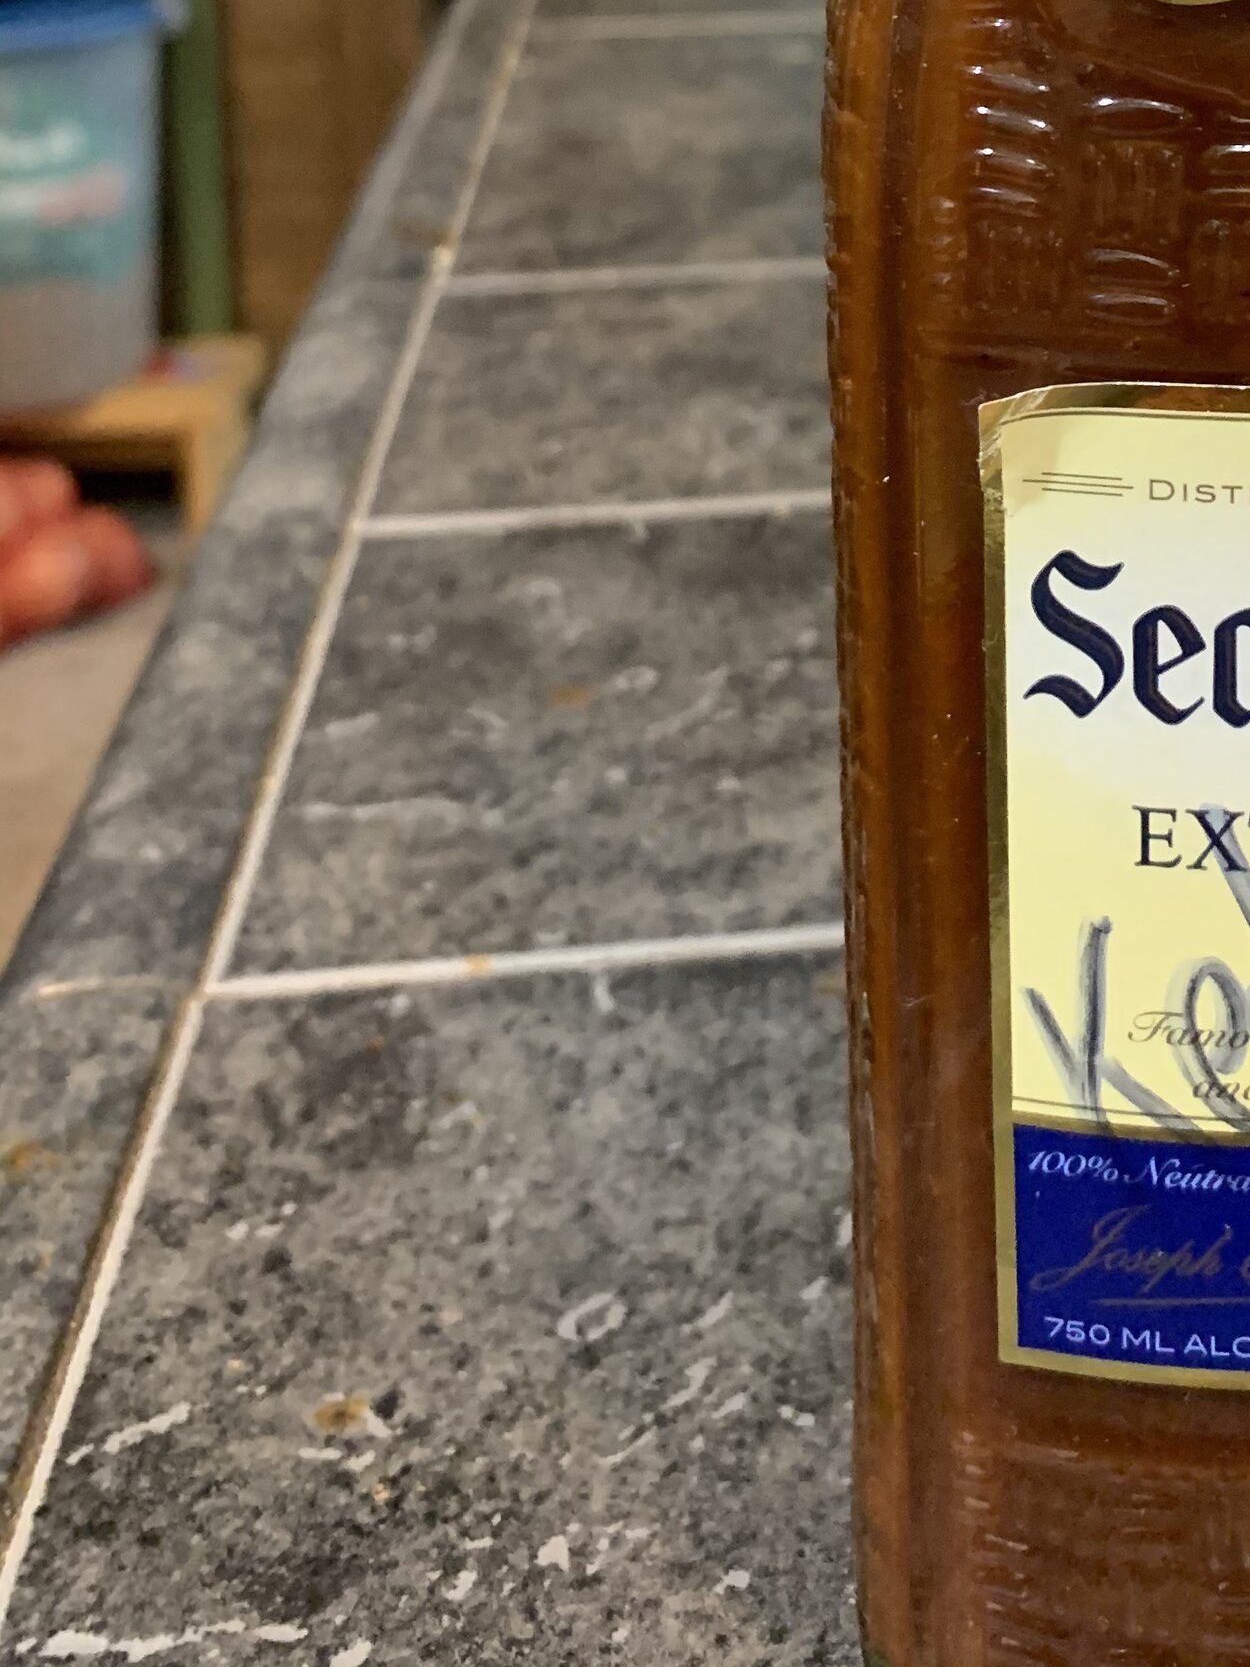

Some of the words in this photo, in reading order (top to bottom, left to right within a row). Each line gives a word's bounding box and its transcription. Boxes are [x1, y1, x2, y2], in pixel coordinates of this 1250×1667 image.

[1028, 1150, 1119, 1183] 100%
[1028, 1204, 1233, 1294] Joseph
[1043, 1315, 1111, 1347] 750
[1120, 1326, 1175, 1354] ML
